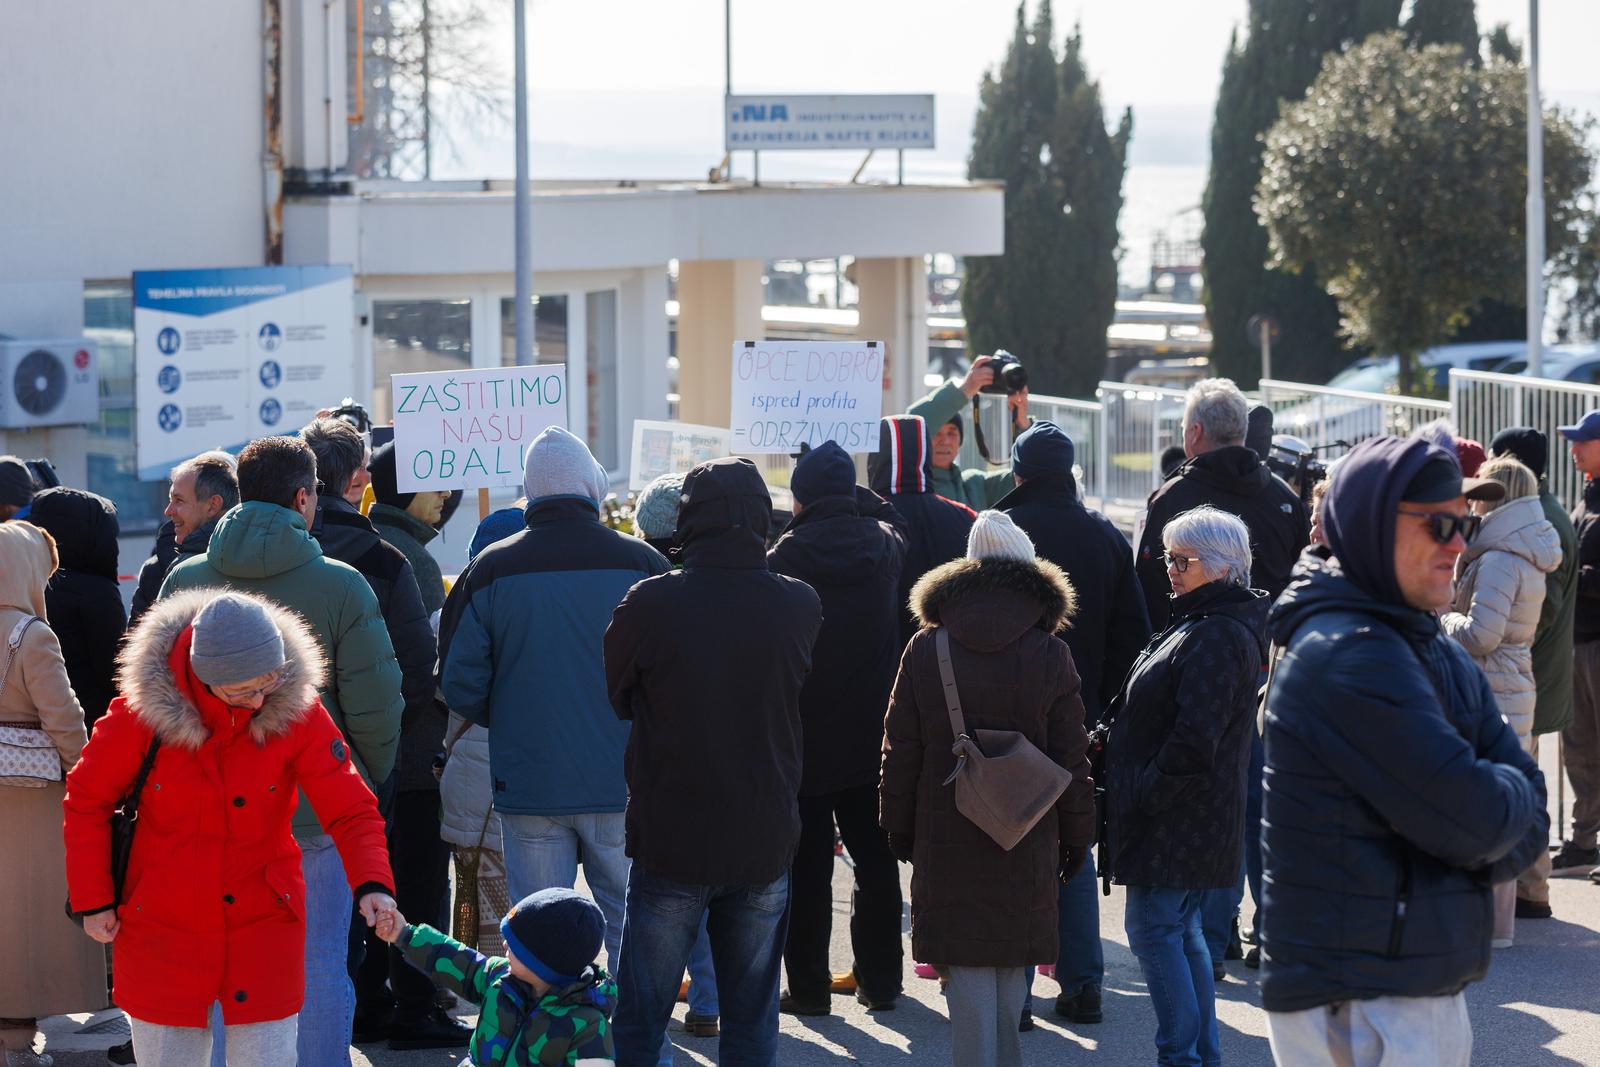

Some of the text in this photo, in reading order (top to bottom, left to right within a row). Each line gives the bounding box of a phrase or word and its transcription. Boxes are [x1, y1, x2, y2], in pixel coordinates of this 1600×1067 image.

[730, 130, 930, 142] RAFINERIJA NAFTE RIJEKA
[195, 286, 233, 298] PRAVILA
[738, 347, 880, 382] OPĆE DOBRO
[397, 374, 562, 413] ZAŠTITIMO
[751, 390, 857, 414] ispred profita
[442, 413, 524, 445] NAŠU
